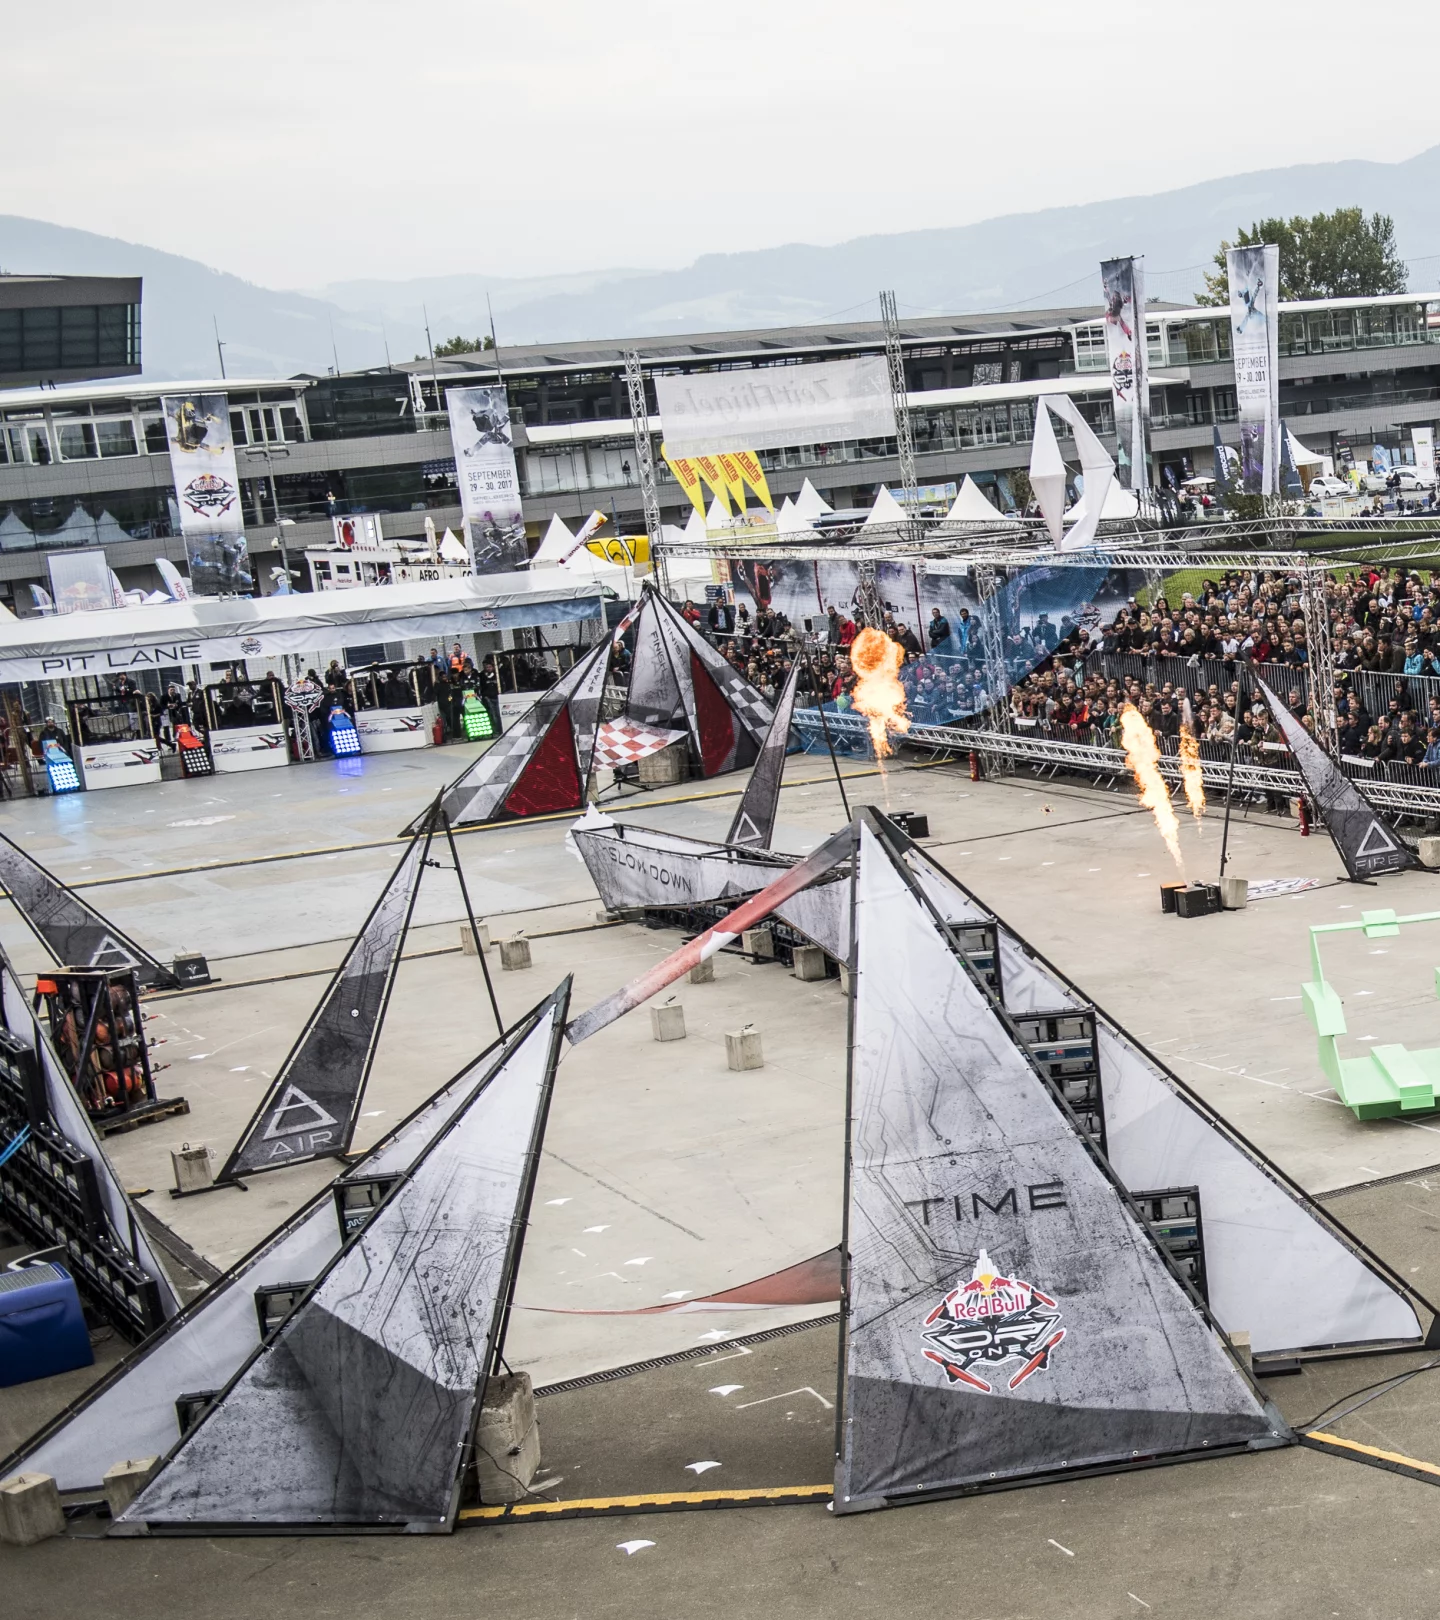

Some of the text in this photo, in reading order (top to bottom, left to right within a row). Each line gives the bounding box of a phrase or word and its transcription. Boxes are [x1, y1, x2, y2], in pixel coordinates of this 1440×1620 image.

[1255, 370, 1266, 382] 201
[395, 397, 408, 417] 7
[468, 469, 512, 482] SEPTEMBER
[1216, 445, 1230, 481] wirecard
[470, 483, 478, 492] 29
[498, 480, 513, 490] 2017
[419, 569, 440, 581] AFRO
[650, 630, 669, 674] FINISH
[663, 617, 687, 666] FINISH
[41, 644, 202, 674] PIT LANE
[588, 659, 605, 693] START
[608, 847, 692, 894] SLOW DOWN
[1355, 854, 1399, 871] FIRE
[269, 1130, 333, 1159] AIR
[904, 1181, 1067, 1226] TIME
[954, 1293, 1025, 1319] Red Bull
[968, 1344, 1021, 1359] ONE
